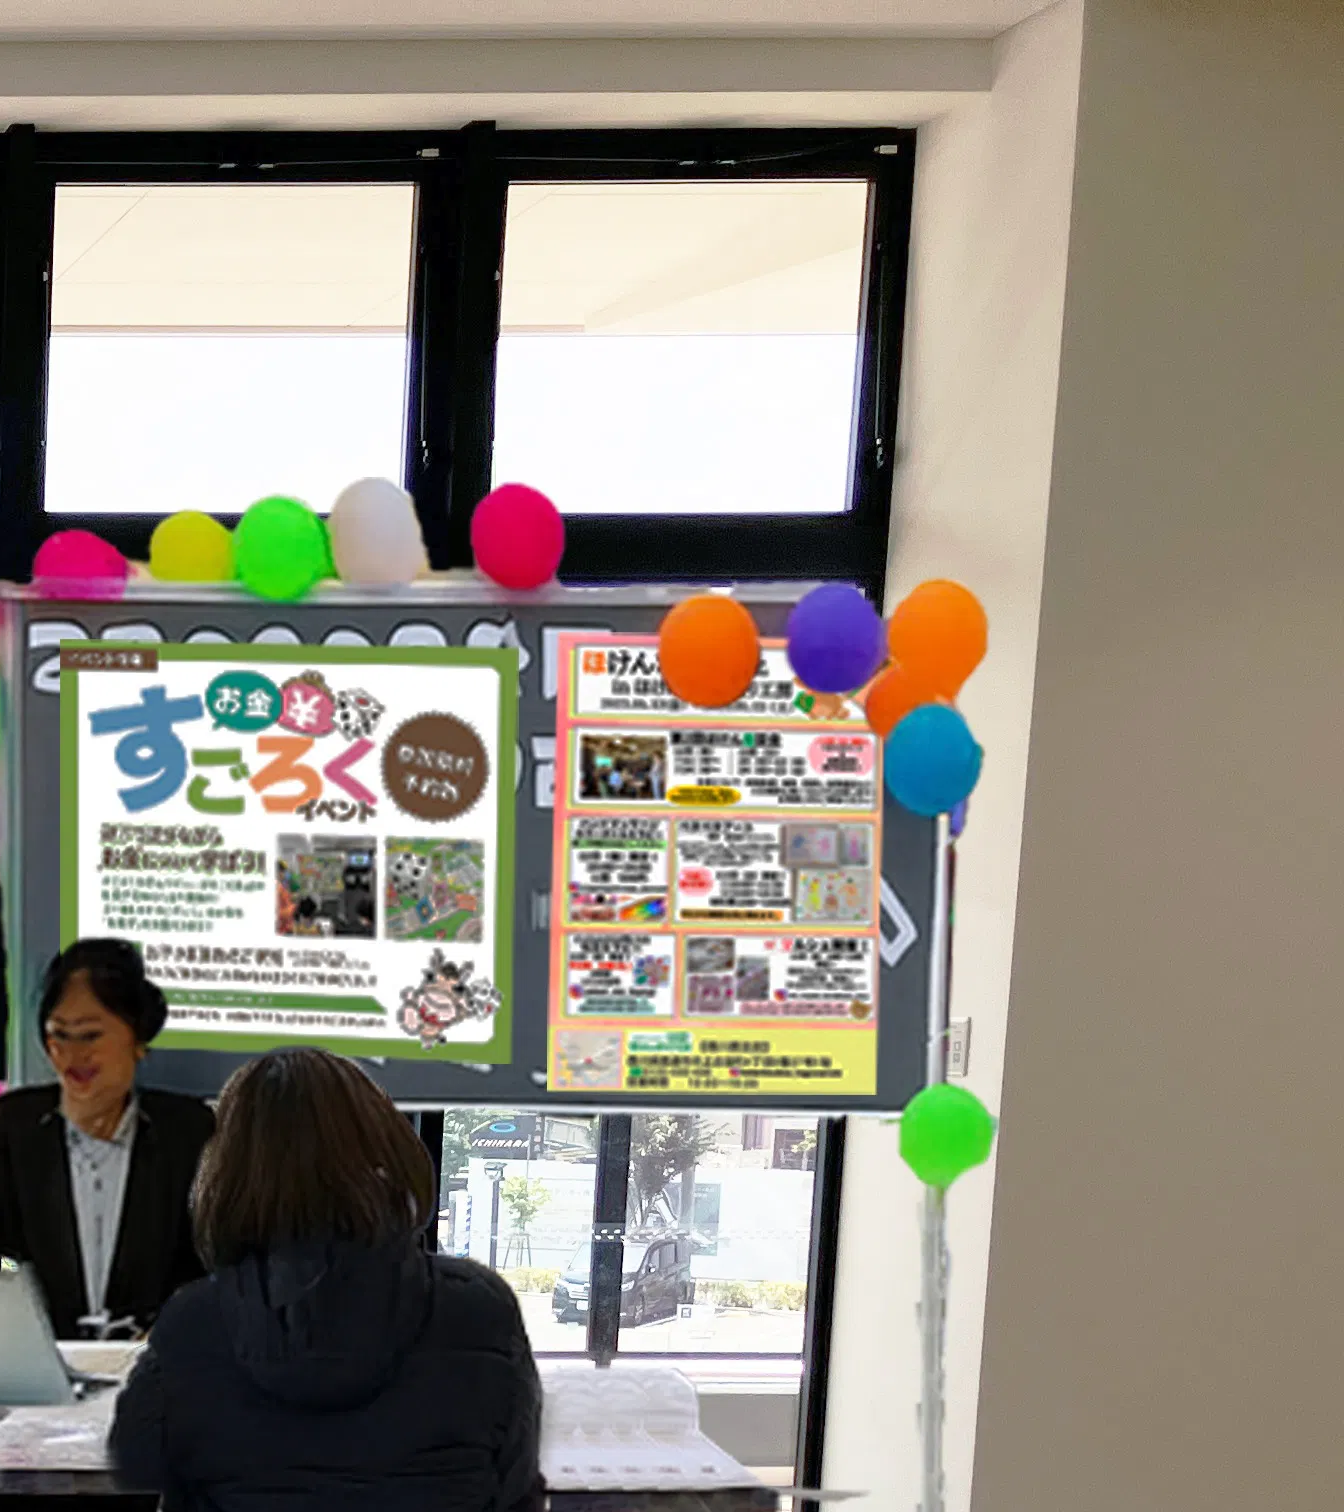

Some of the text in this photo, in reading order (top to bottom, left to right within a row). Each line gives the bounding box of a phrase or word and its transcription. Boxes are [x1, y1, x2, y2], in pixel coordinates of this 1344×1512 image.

[214, 686, 273, 718] お金
[88, 685, 379, 815] すごろく
[296, 798, 378, 823] イベント
